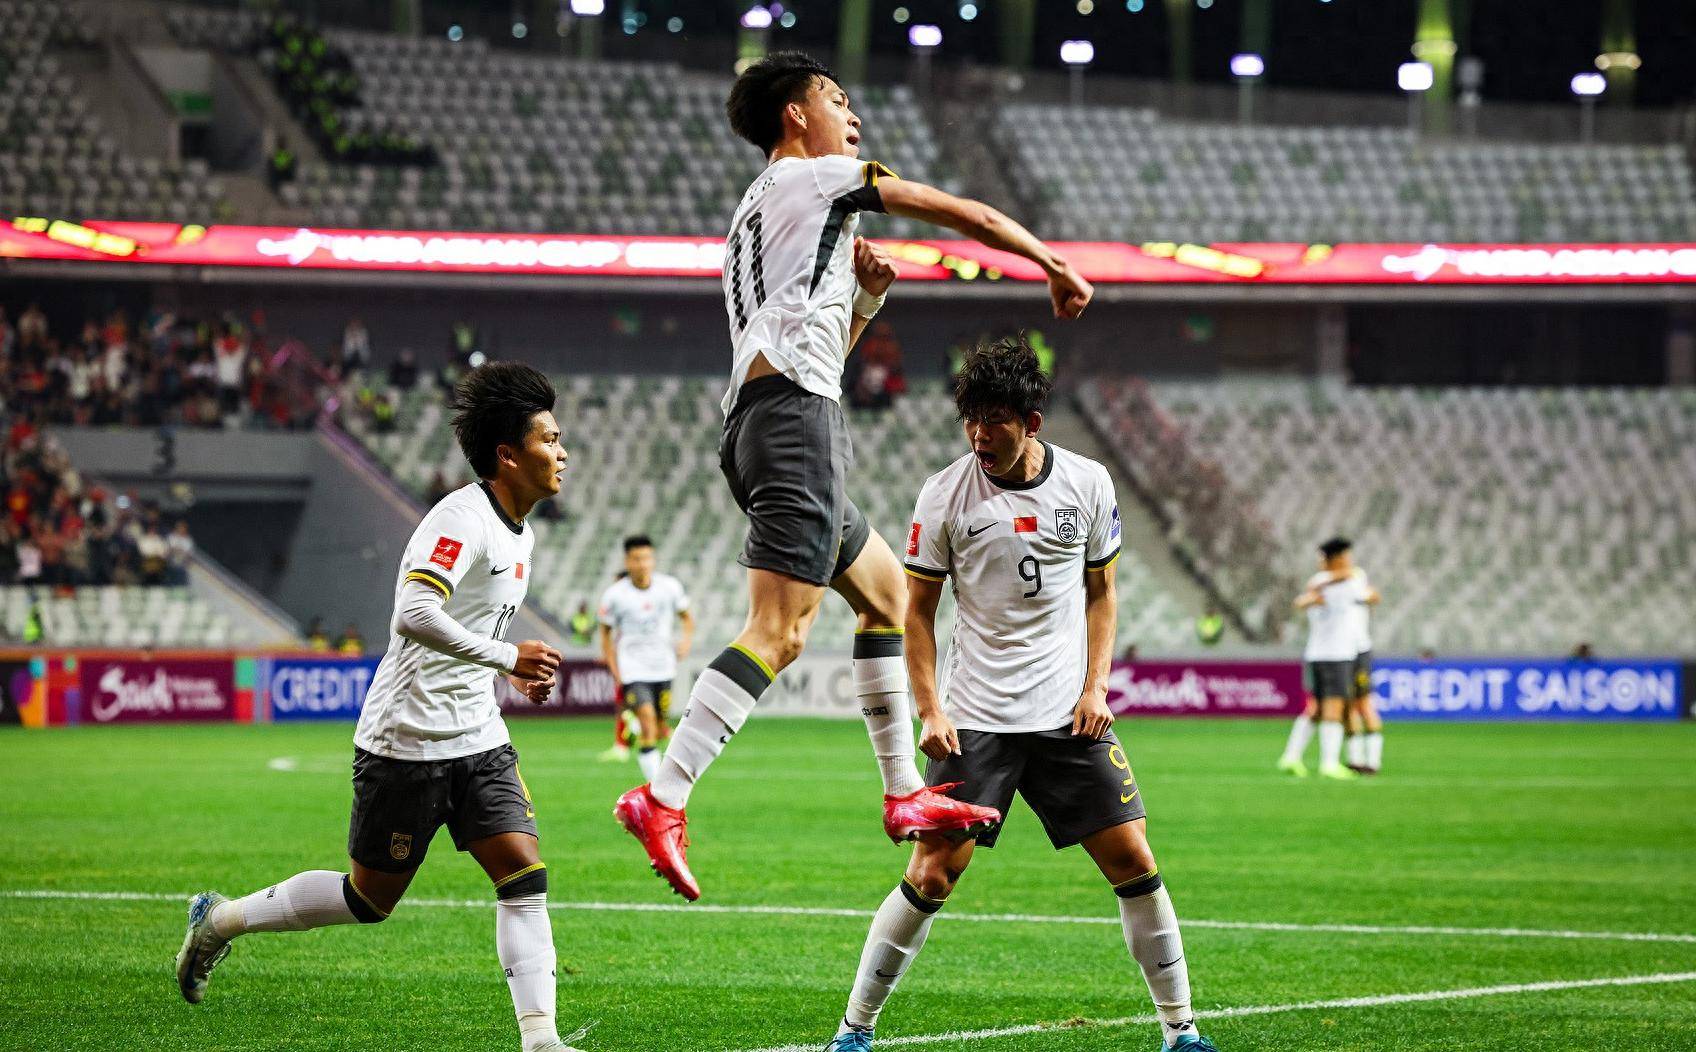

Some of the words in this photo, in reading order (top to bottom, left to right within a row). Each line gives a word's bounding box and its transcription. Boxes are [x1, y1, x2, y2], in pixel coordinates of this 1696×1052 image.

[729, 211, 767, 332] 11
[1018, 555, 1042, 598] 9
[272, 667, 372, 712] CREDIT
[1371, 668, 1511, 712] CREDIT
[1517, 668, 1675, 712] SAISON
[1108, 745, 1132, 786] 9
